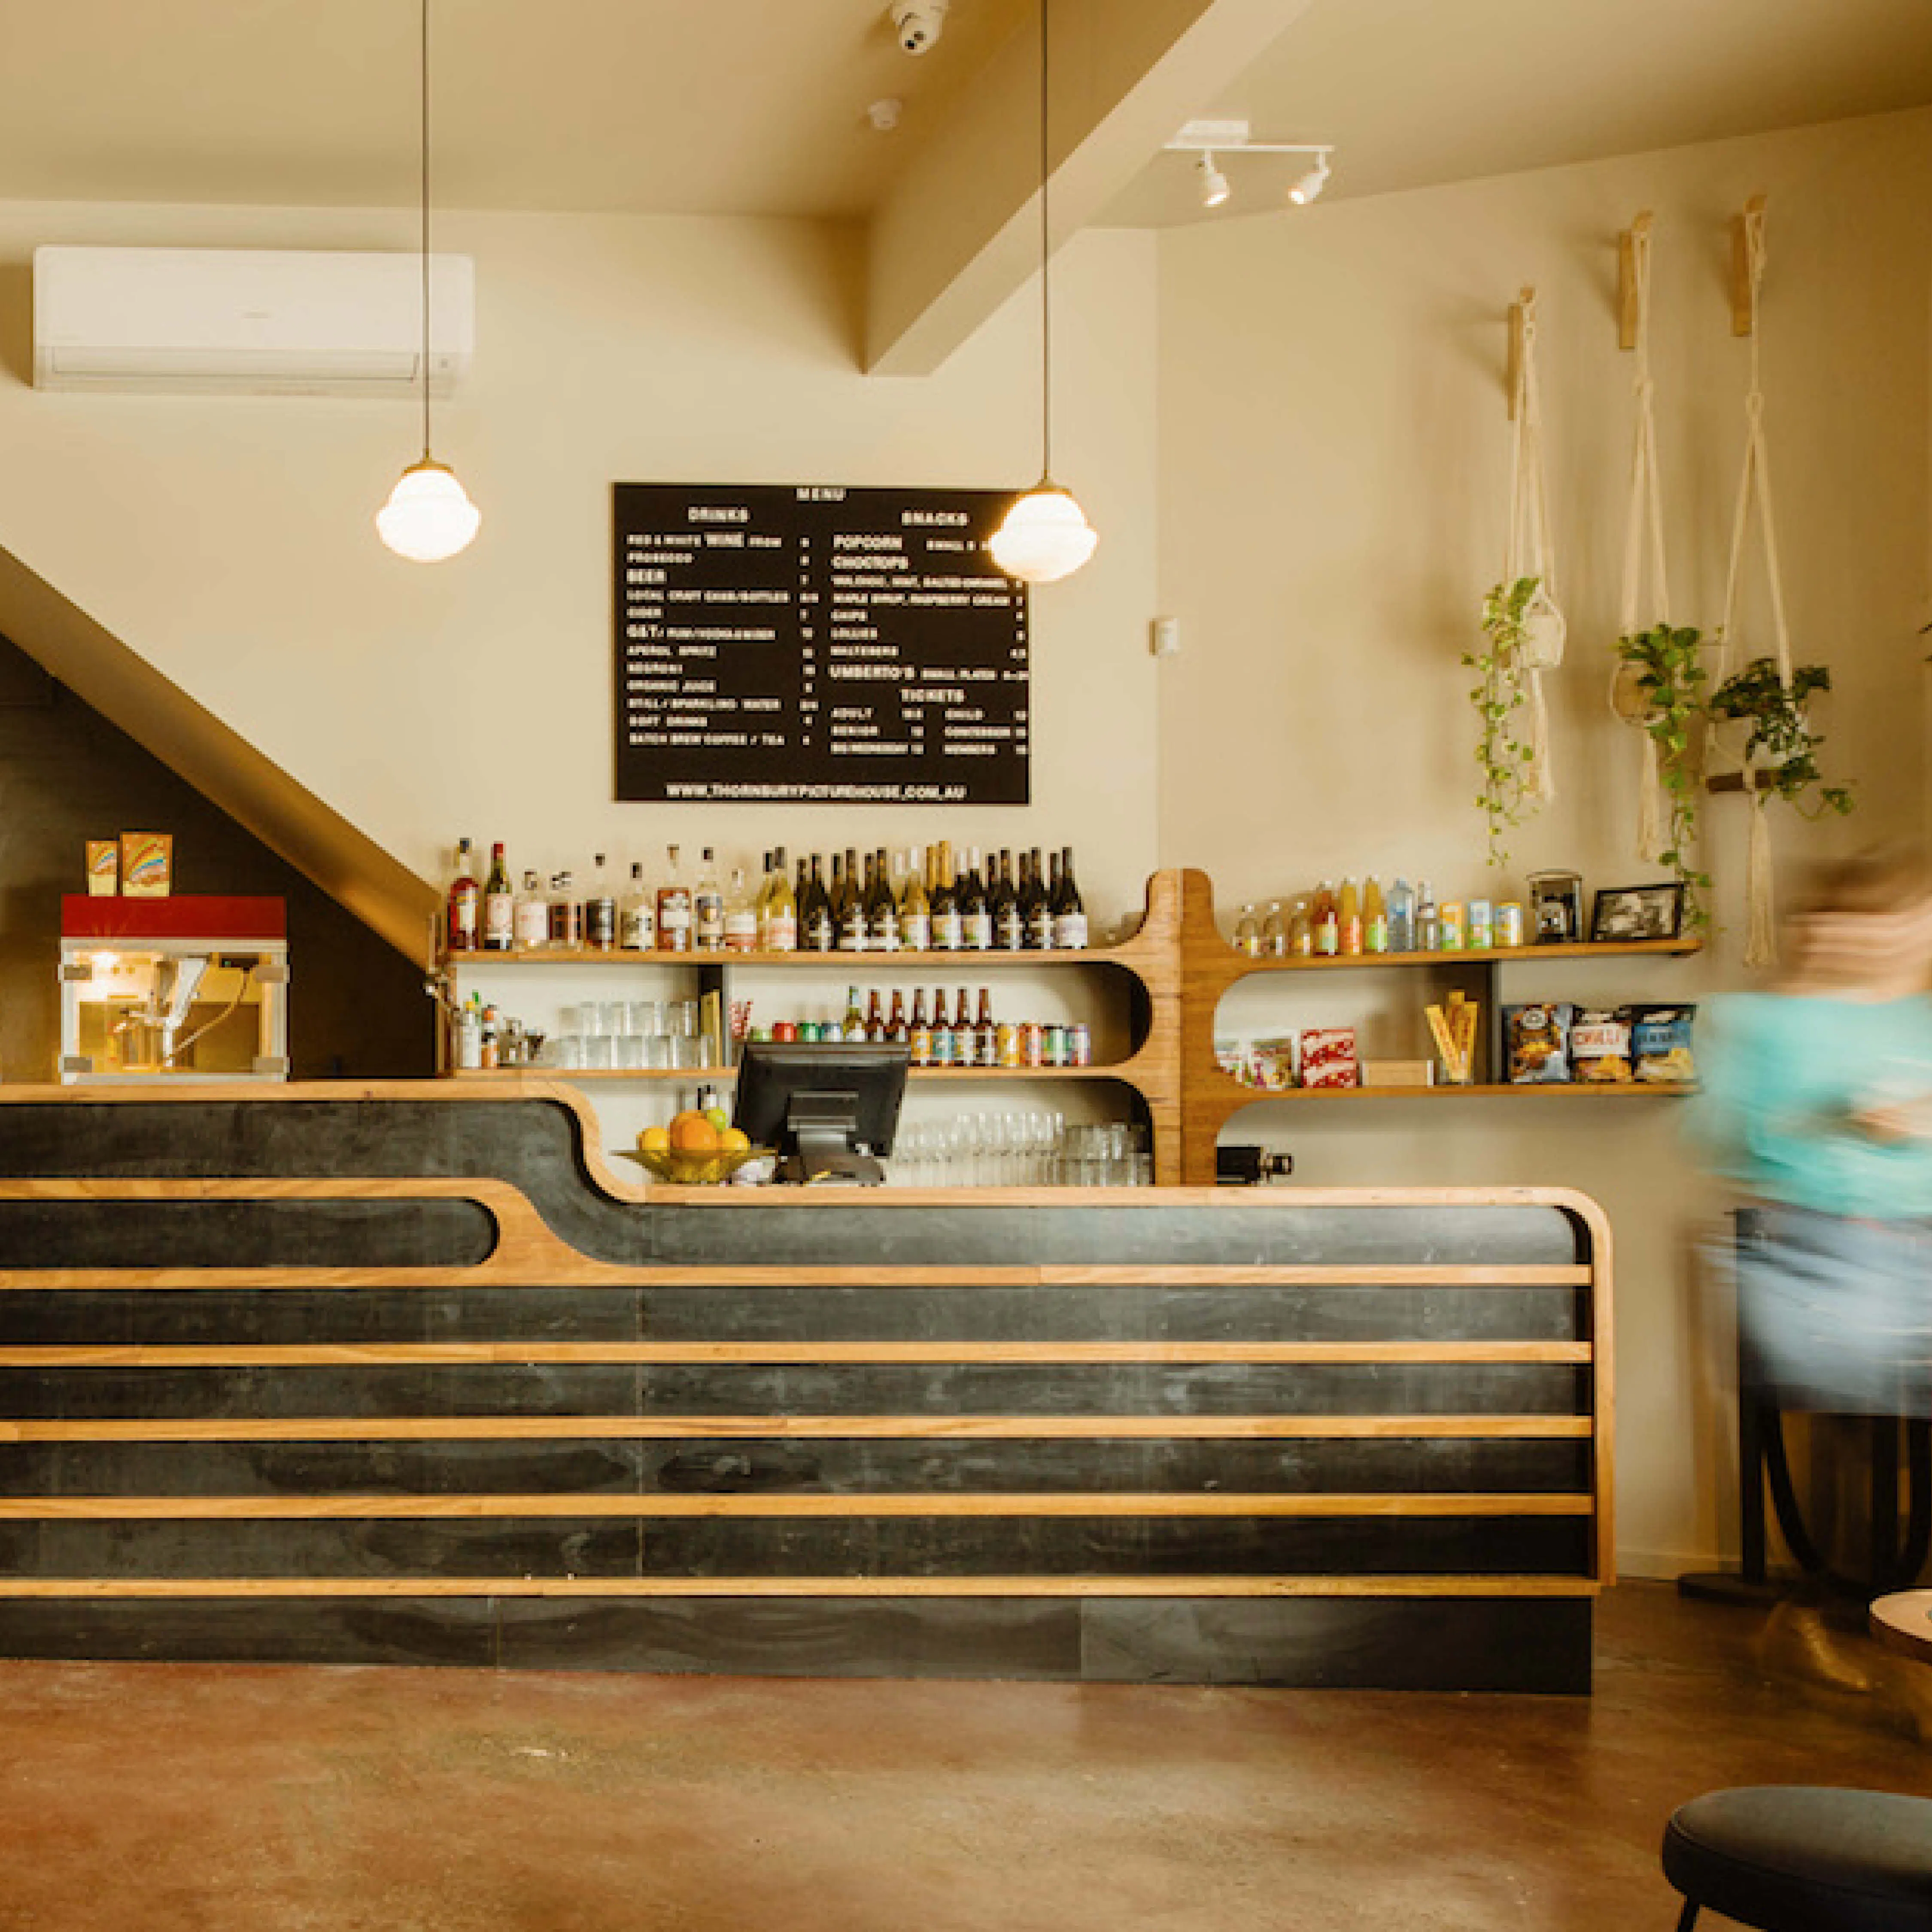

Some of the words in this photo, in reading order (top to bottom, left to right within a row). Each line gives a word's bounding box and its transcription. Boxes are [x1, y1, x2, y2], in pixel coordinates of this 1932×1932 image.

[796, 488, 845, 501] MENU
[688, 507, 750, 522] DRINKS
[902, 511, 967, 526] SNACKS
[704, 532, 744, 547] WINE
[833, 535, 902, 550] POPCORN
[626, 551, 694, 563] PROSECCO
[831, 556, 908, 569] CHOCTOPS
[626, 568, 667, 584] BEER
[626, 590, 664, 602] LOCAL
[626, 606, 662, 618] CIDER
[831, 609, 868, 622] CHIPS
[626, 645, 673, 656] APEROL
[626, 662, 683, 674] NEGRONI
[829, 665, 914, 680] UMBERTO'S
[626, 680, 677, 692] ORGANIC
[682, 680, 717, 693] JUICE
[901, 689, 964, 702] TICKETS
[741, 699, 781, 711] WATER
[629, 714, 661, 726] SOFT
[831, 708, 874, 720] ADULT
[831, 723, 880, 736] SENIOR
[629, 732, 667, 745] BATCH
[669, 732, 701, 745] BREW
[762, 733, 785, 745] TEA
[666, 783, 967, 800] WWW.THORNBURYPICTUREHOUSE.COM.AU
